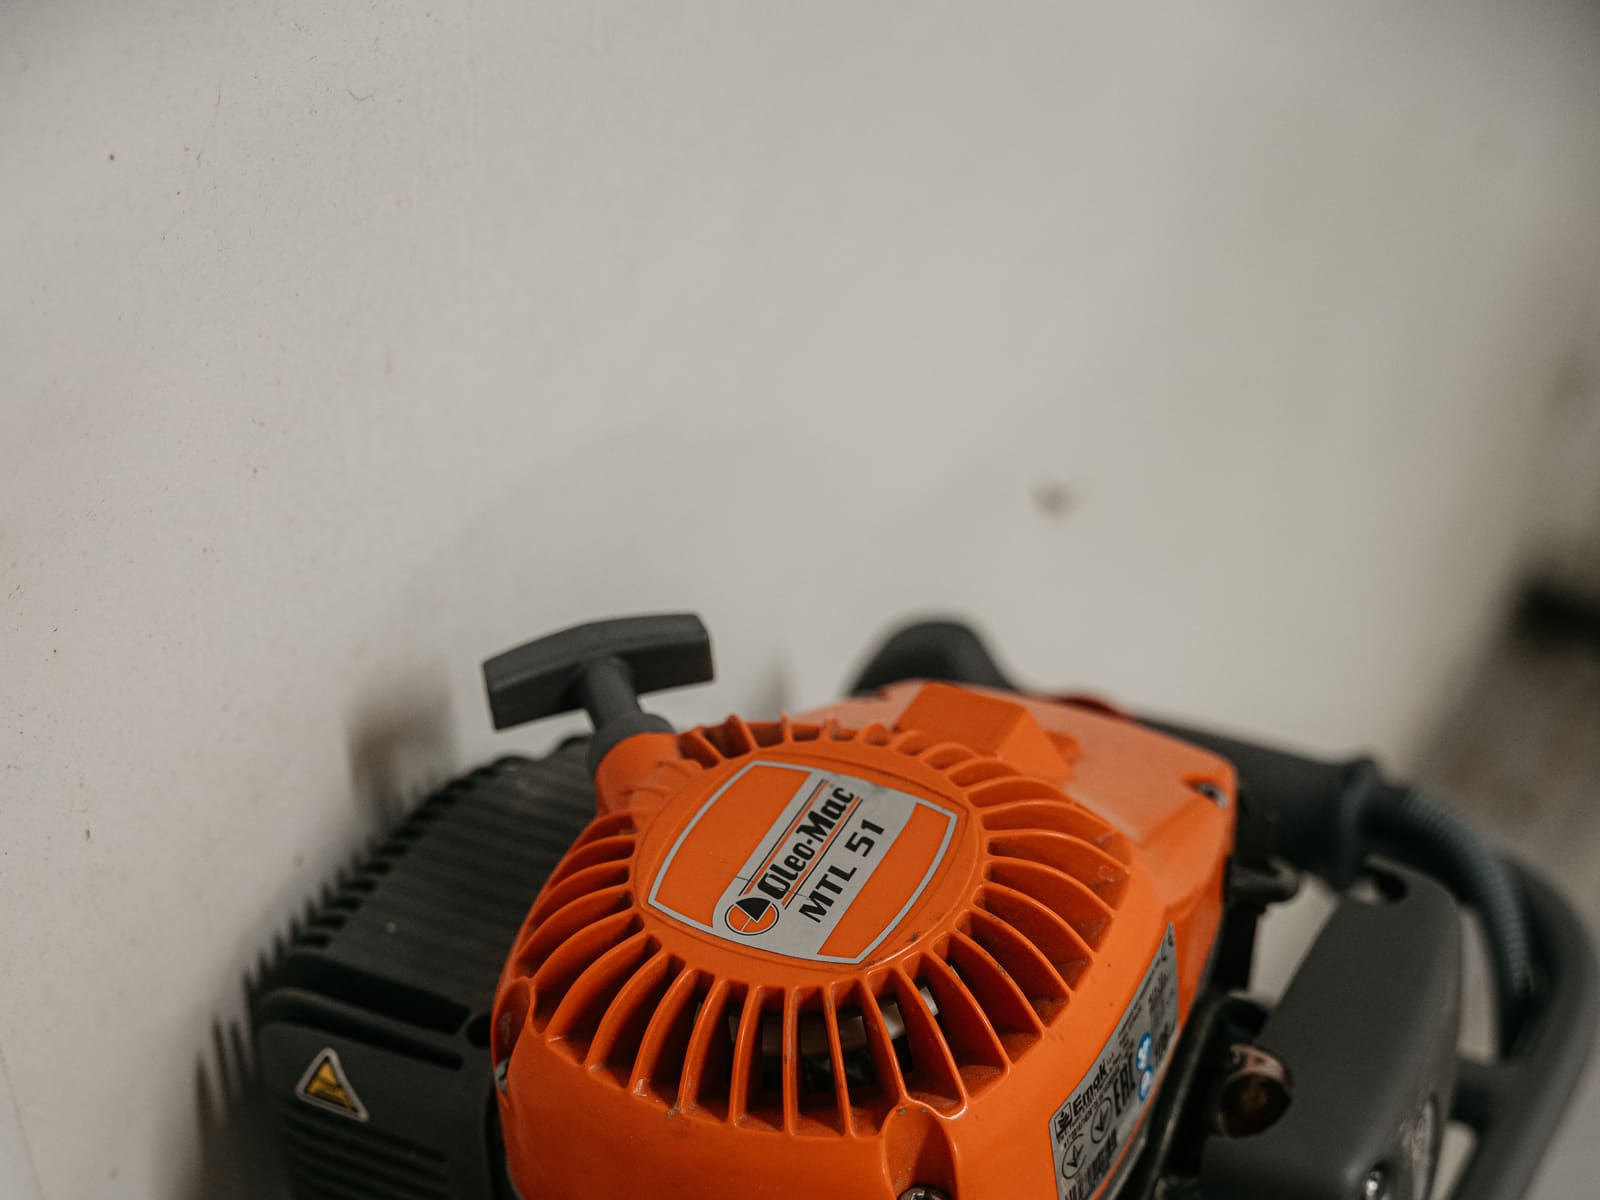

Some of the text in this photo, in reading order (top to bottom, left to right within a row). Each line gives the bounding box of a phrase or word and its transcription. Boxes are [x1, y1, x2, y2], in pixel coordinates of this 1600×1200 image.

[757, 787, 854, 900] Oleo-Mac
[798, 818, 885, 923] MTL 51
[1072, 1060, 1107, 1117] Emak
